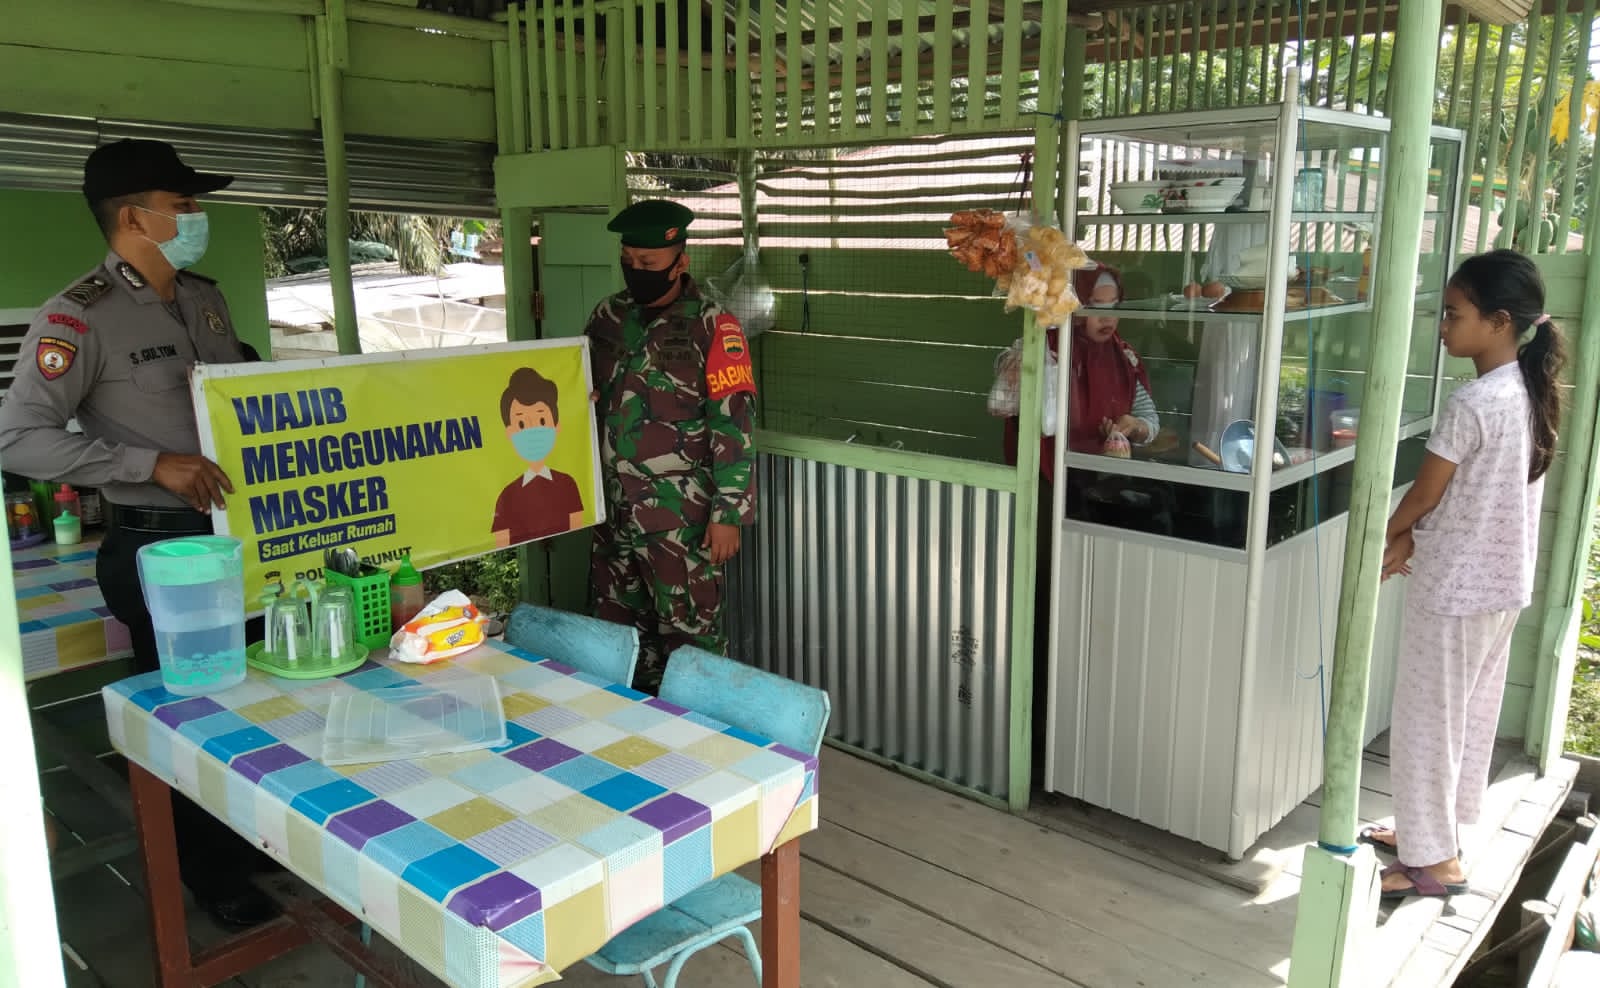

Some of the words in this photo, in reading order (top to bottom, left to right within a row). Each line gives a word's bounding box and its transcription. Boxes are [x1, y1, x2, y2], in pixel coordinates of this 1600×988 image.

[231, 387, 347, 436] WAJIB
[241, 416, 482, 485] MENGGUNAKAN
[248, 476, 389, 534] MASKER
[262, 540, 295, 559] Saat
[298, 529, 344, 550] Keluar
[346, 518, 393, 540] Rumah
[295, 567, 325, 583] POL
